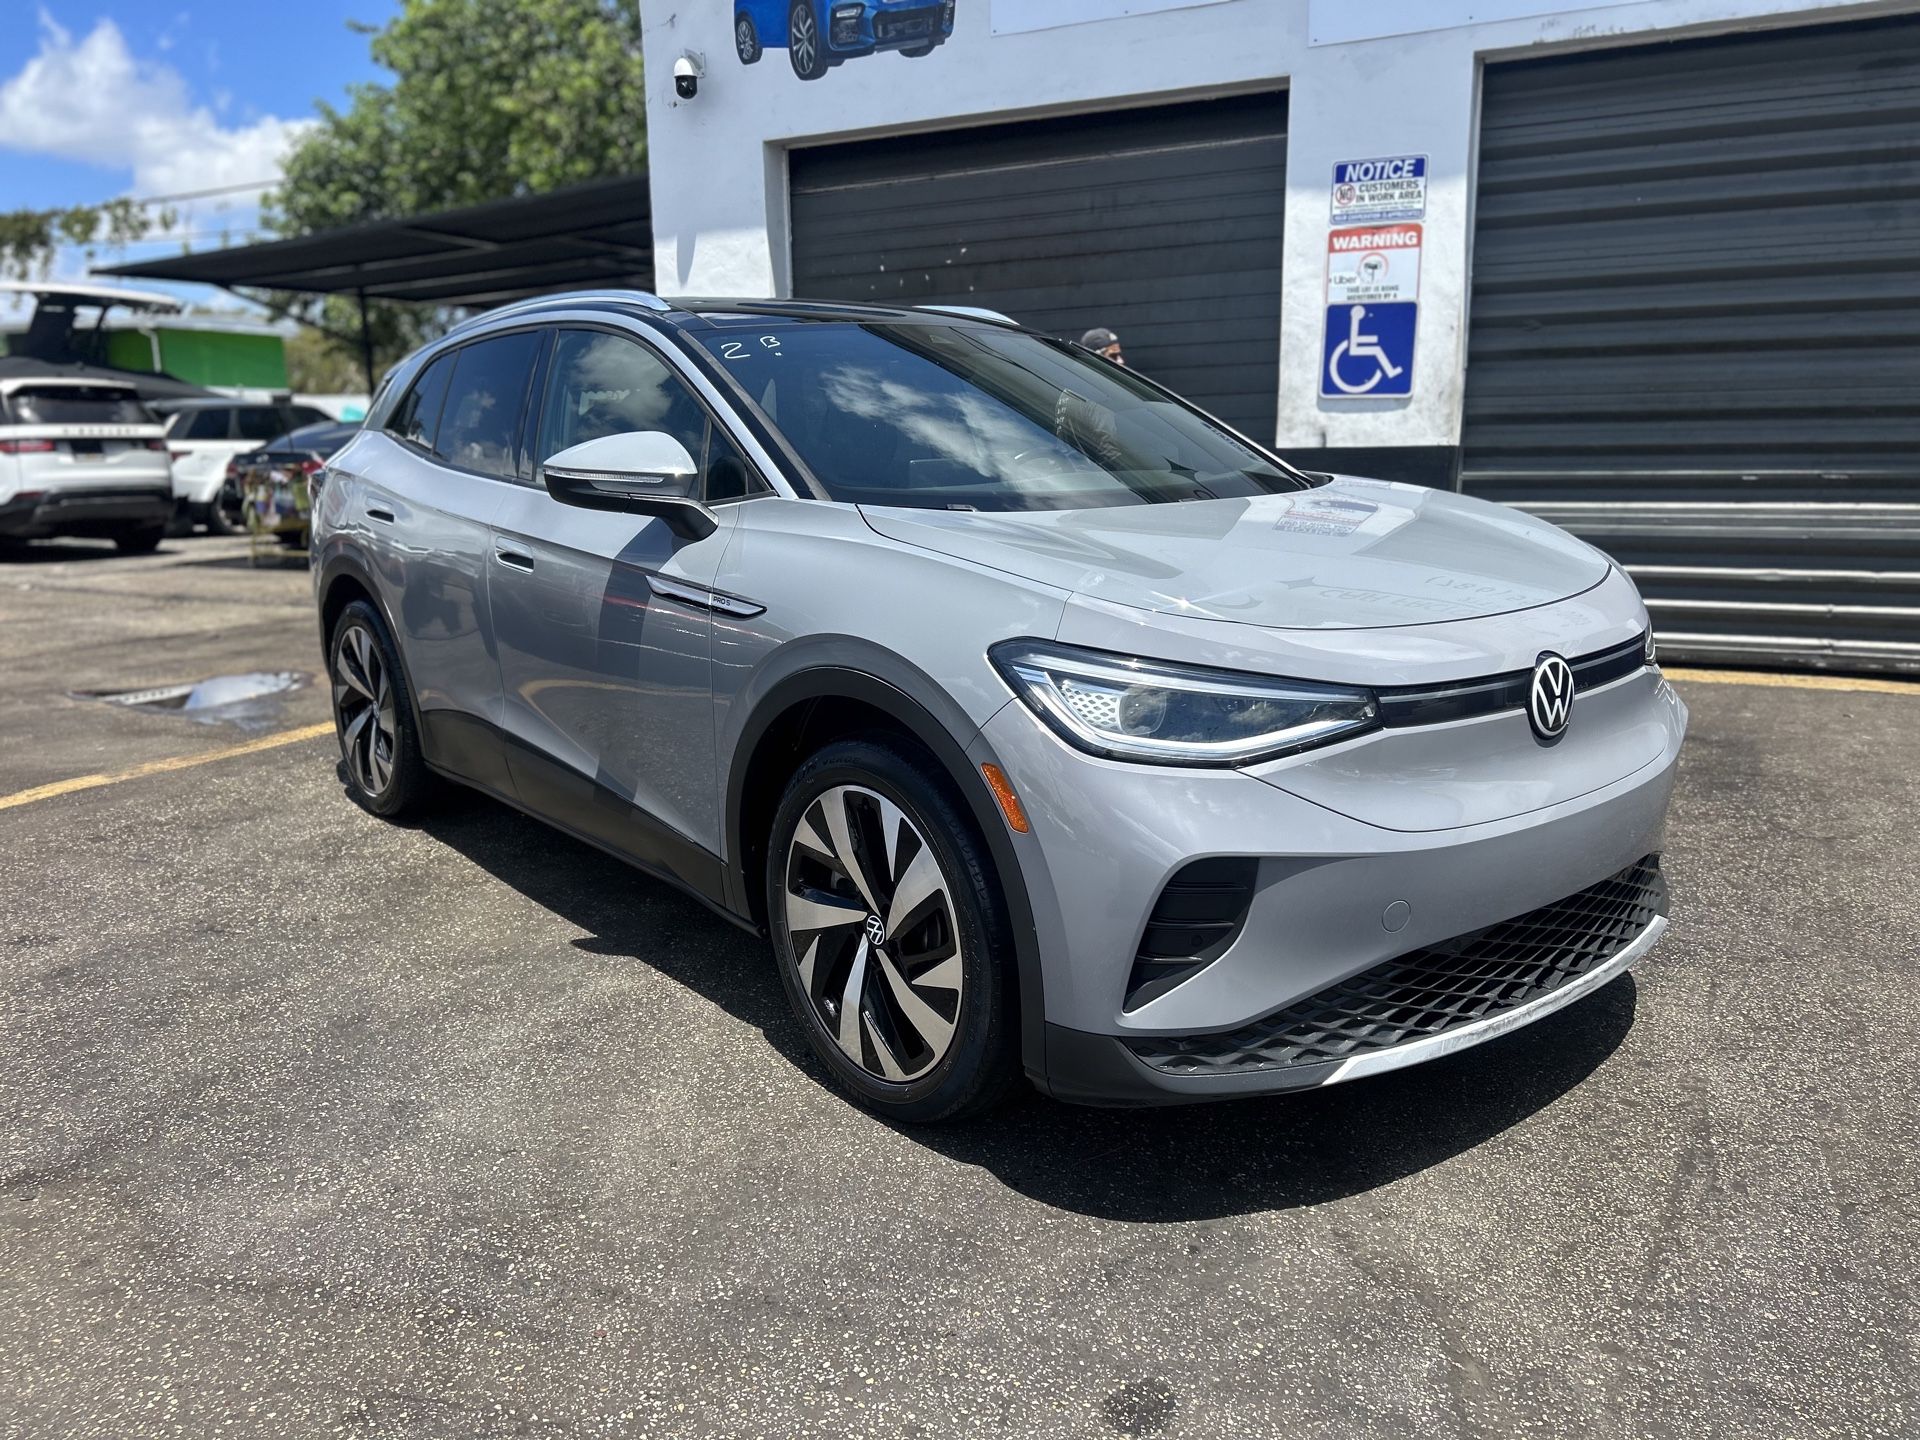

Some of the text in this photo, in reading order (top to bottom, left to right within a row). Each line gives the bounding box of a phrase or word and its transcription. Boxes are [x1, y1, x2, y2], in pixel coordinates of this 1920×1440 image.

[1345, 160, 1415, 182] NOTICE
[1359, 181, 1419, 192] CUSTOMERS
[1356, 191, 1422, 203] IN WORK AREA
[1332, 231, 1418, 250] WARNING
[713, 595, 725, 605] PRO
